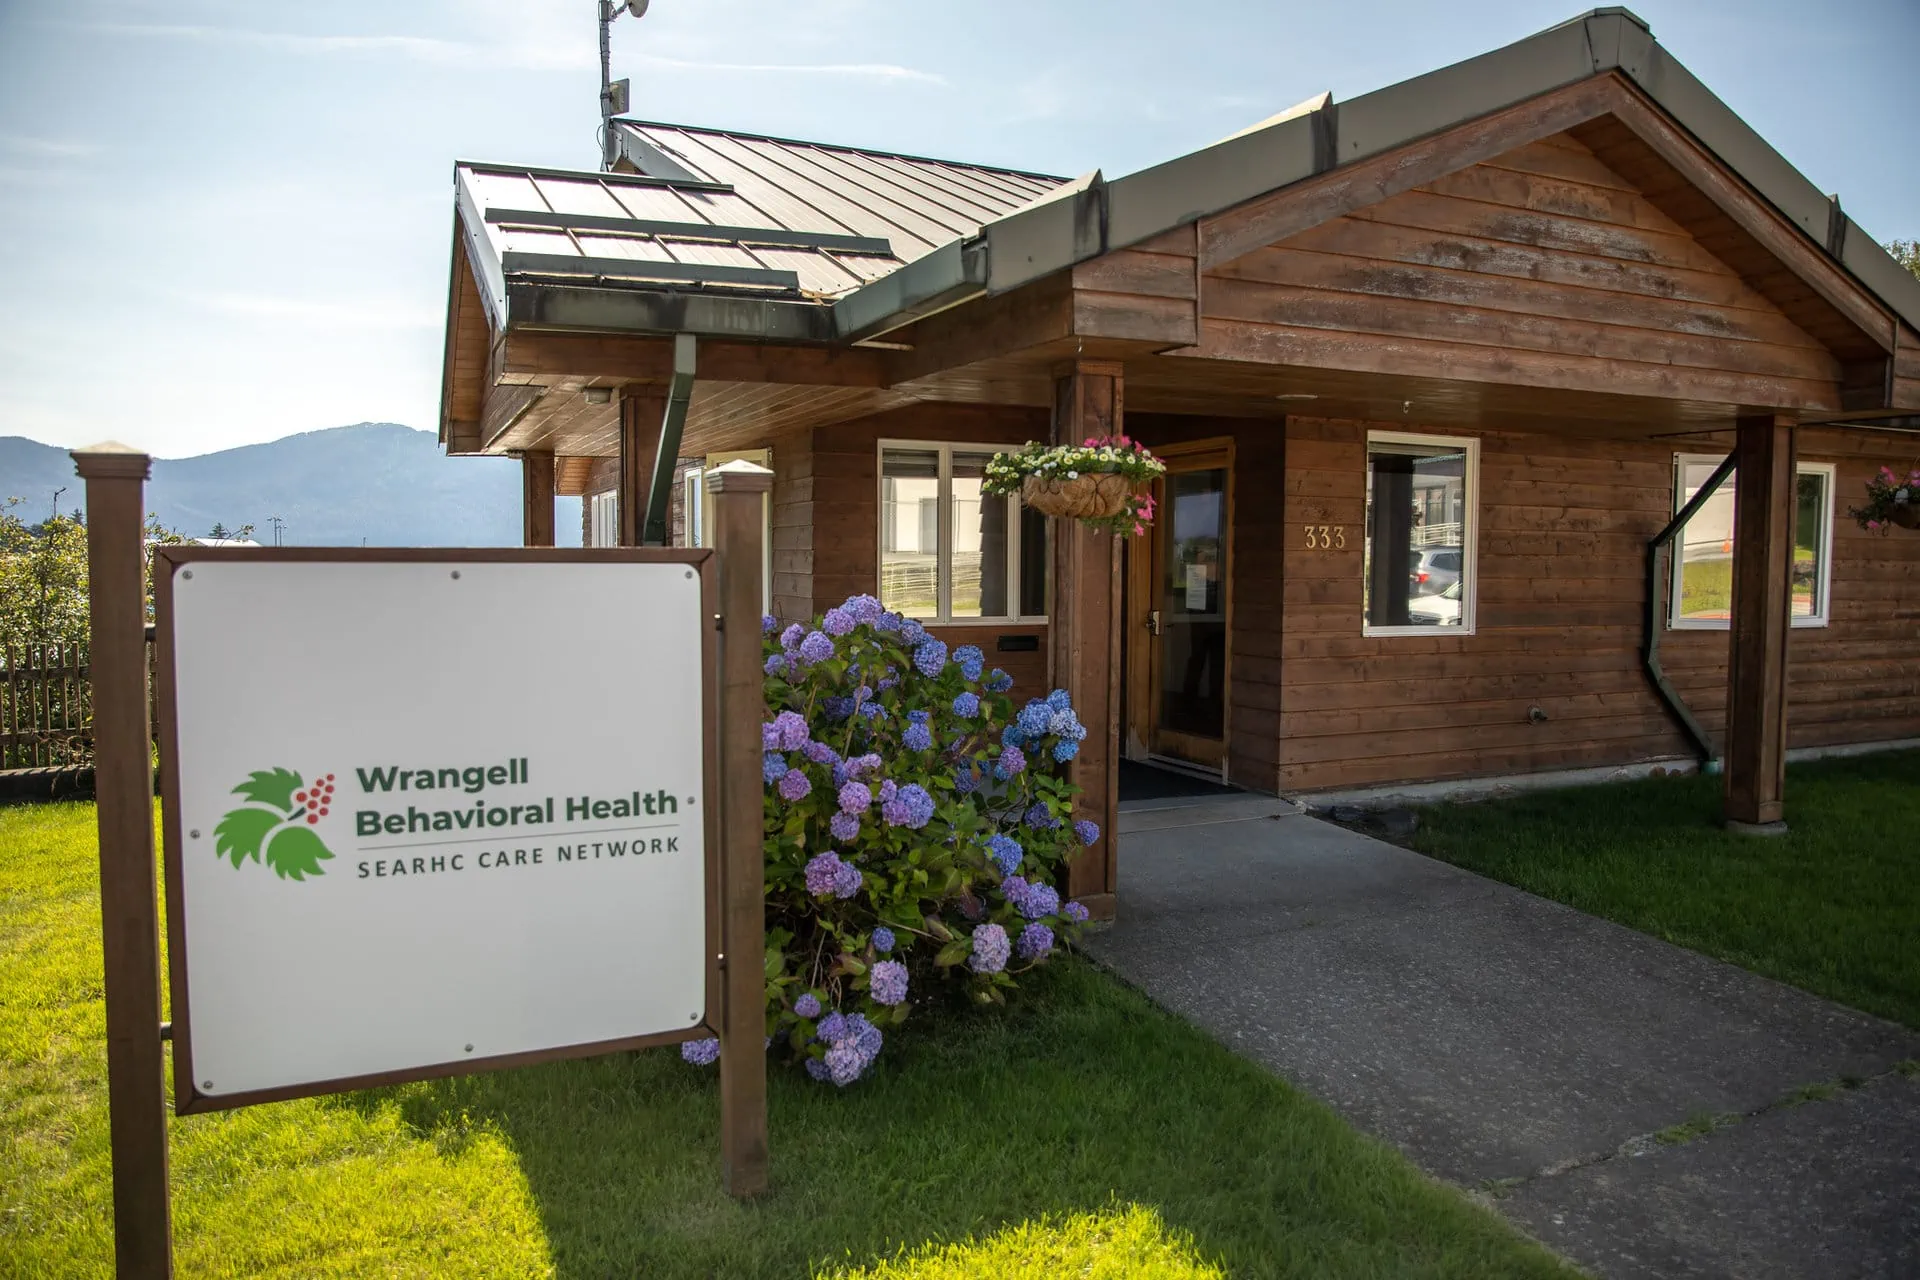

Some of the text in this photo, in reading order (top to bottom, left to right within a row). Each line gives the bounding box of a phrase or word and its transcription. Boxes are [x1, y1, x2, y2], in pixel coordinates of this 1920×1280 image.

[1303, 525, 1346, 550] 333
[355, 757, 529, 794] Wrangell
[355, 789, 678, 837] Behavioral Health
[358, 836, 679, 879] SEARHC CARE NETWORK
